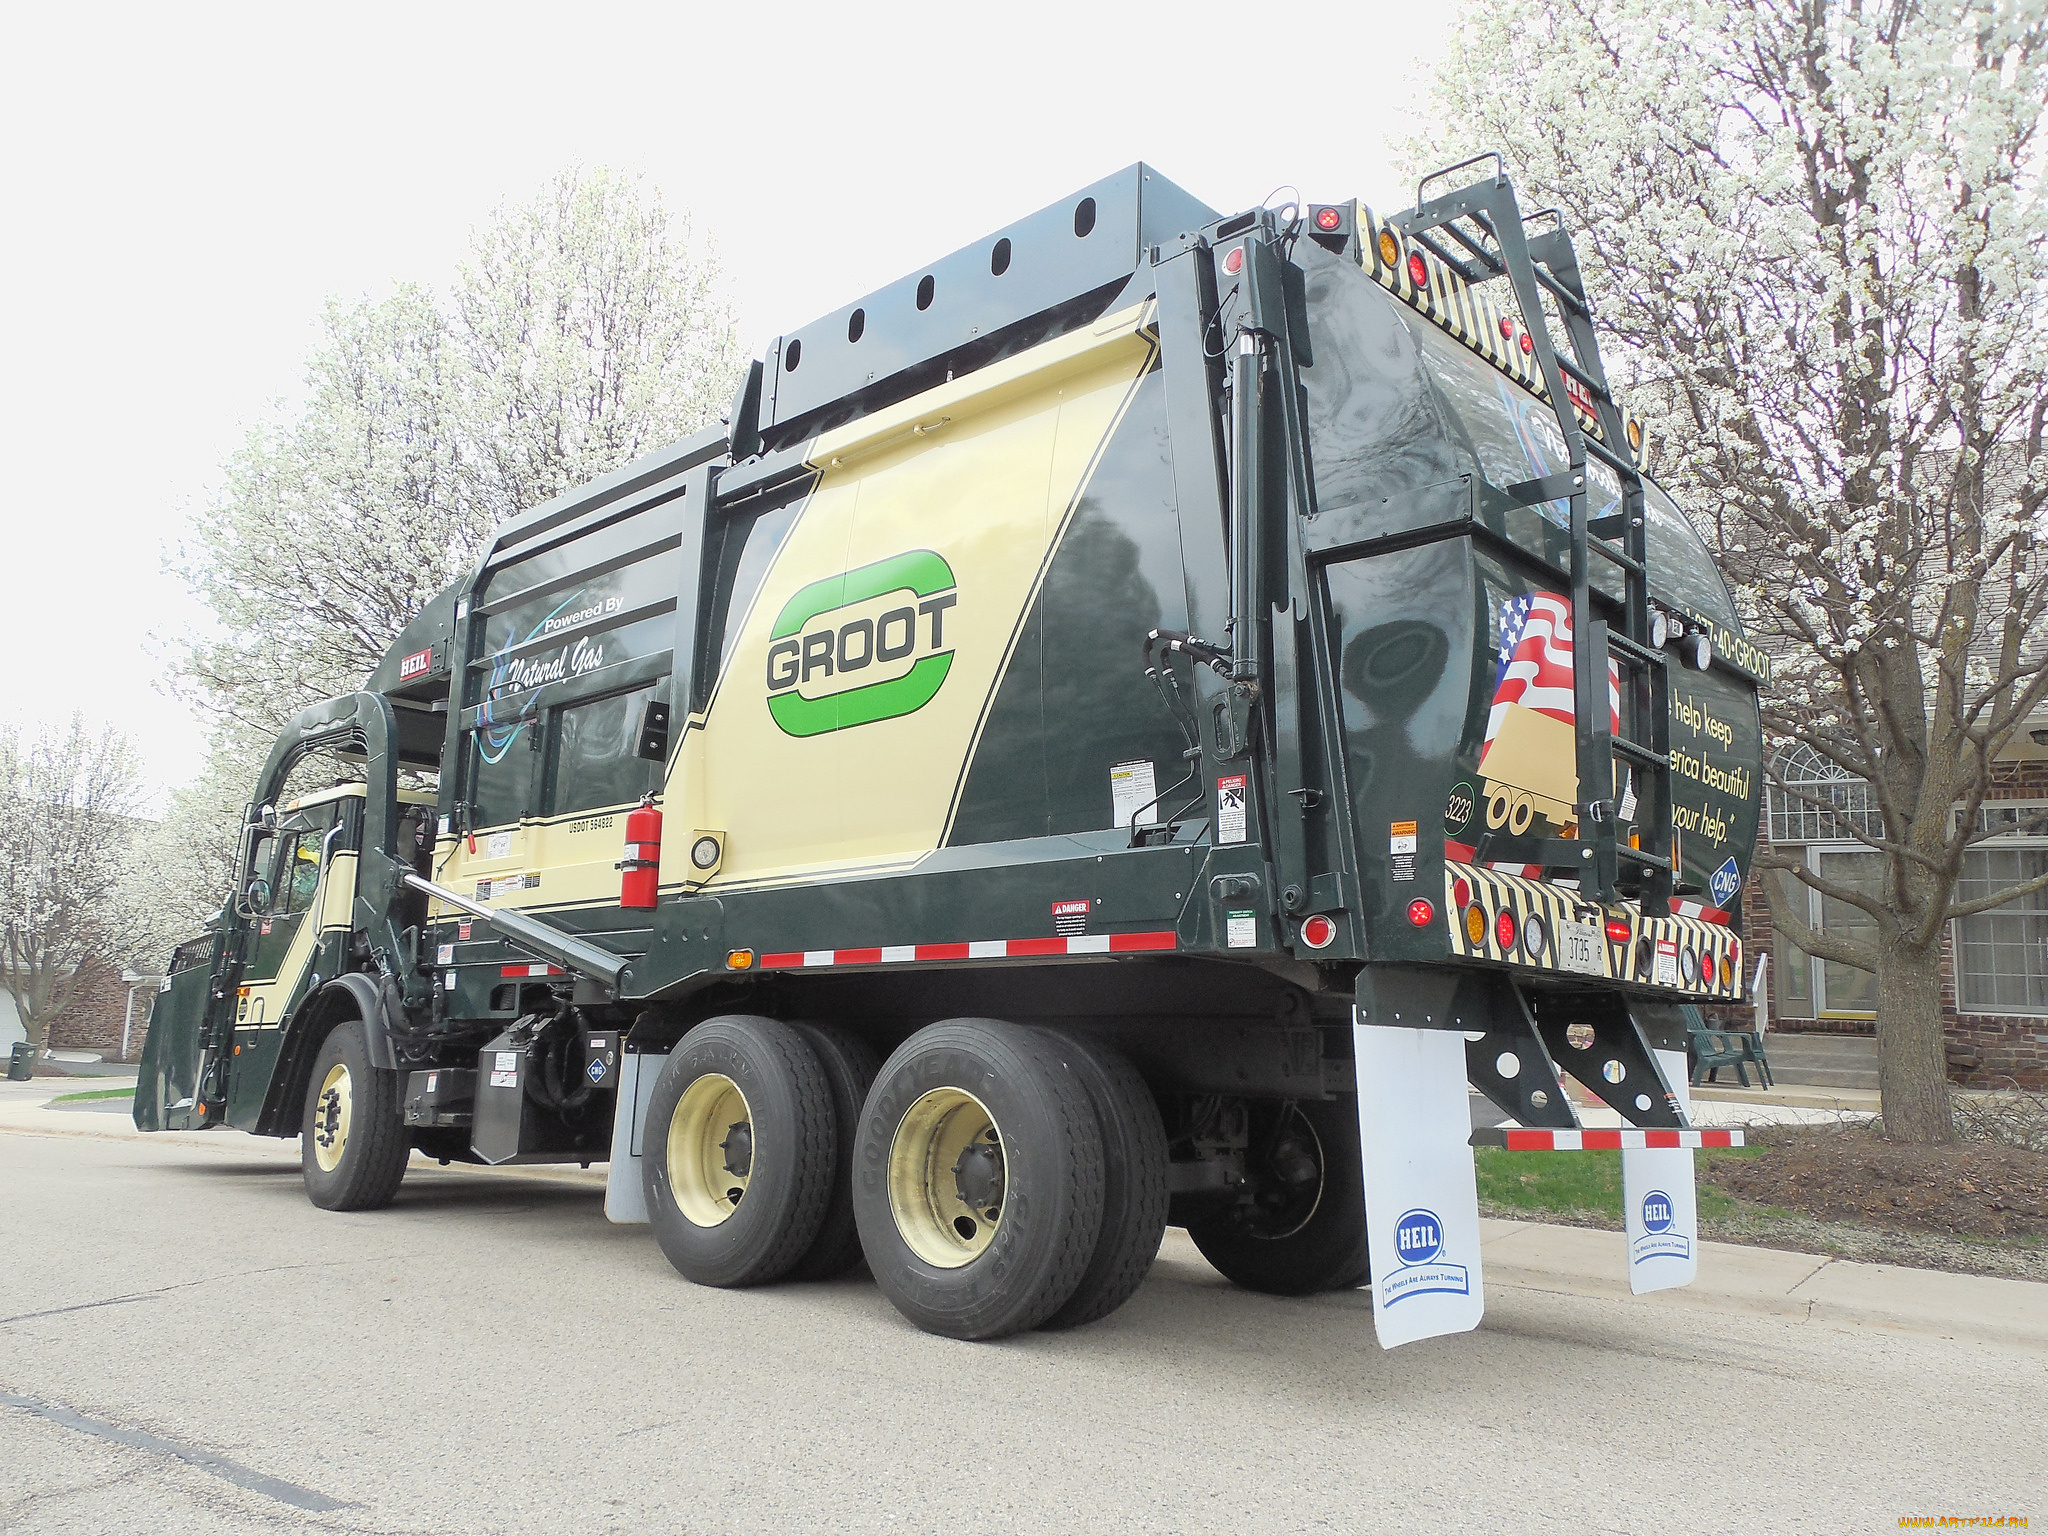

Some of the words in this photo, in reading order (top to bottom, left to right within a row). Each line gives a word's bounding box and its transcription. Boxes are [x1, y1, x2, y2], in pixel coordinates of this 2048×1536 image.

[544, 605, 602, 633] Powered
[605, 595, 625, 614] By
[767, 593, 957, 691] GROOT
[401, 653, 427, 678] HEIL
[508, 646, 568, 692] Natural
[563, 636, 604, 683] Gas
[1674, 688, 1702, 738] help
[1704, 702, 1734, 752] keep
[1702, 751, 1750, 800] beautiful
[1445, 794, 1472, 824] 3223
[1671, 803, 1700, 832] your
[569, 820, 589, 833] USDOT
[590, 816, 613, 830] 564822
[1714, 870, 1737, 892] CNG
[1062, 903, 1087, 913] DANGER
[1645, 1203, 1671, 1222] HEIL
[1400, 1226, 1439, 1250] HEIL
